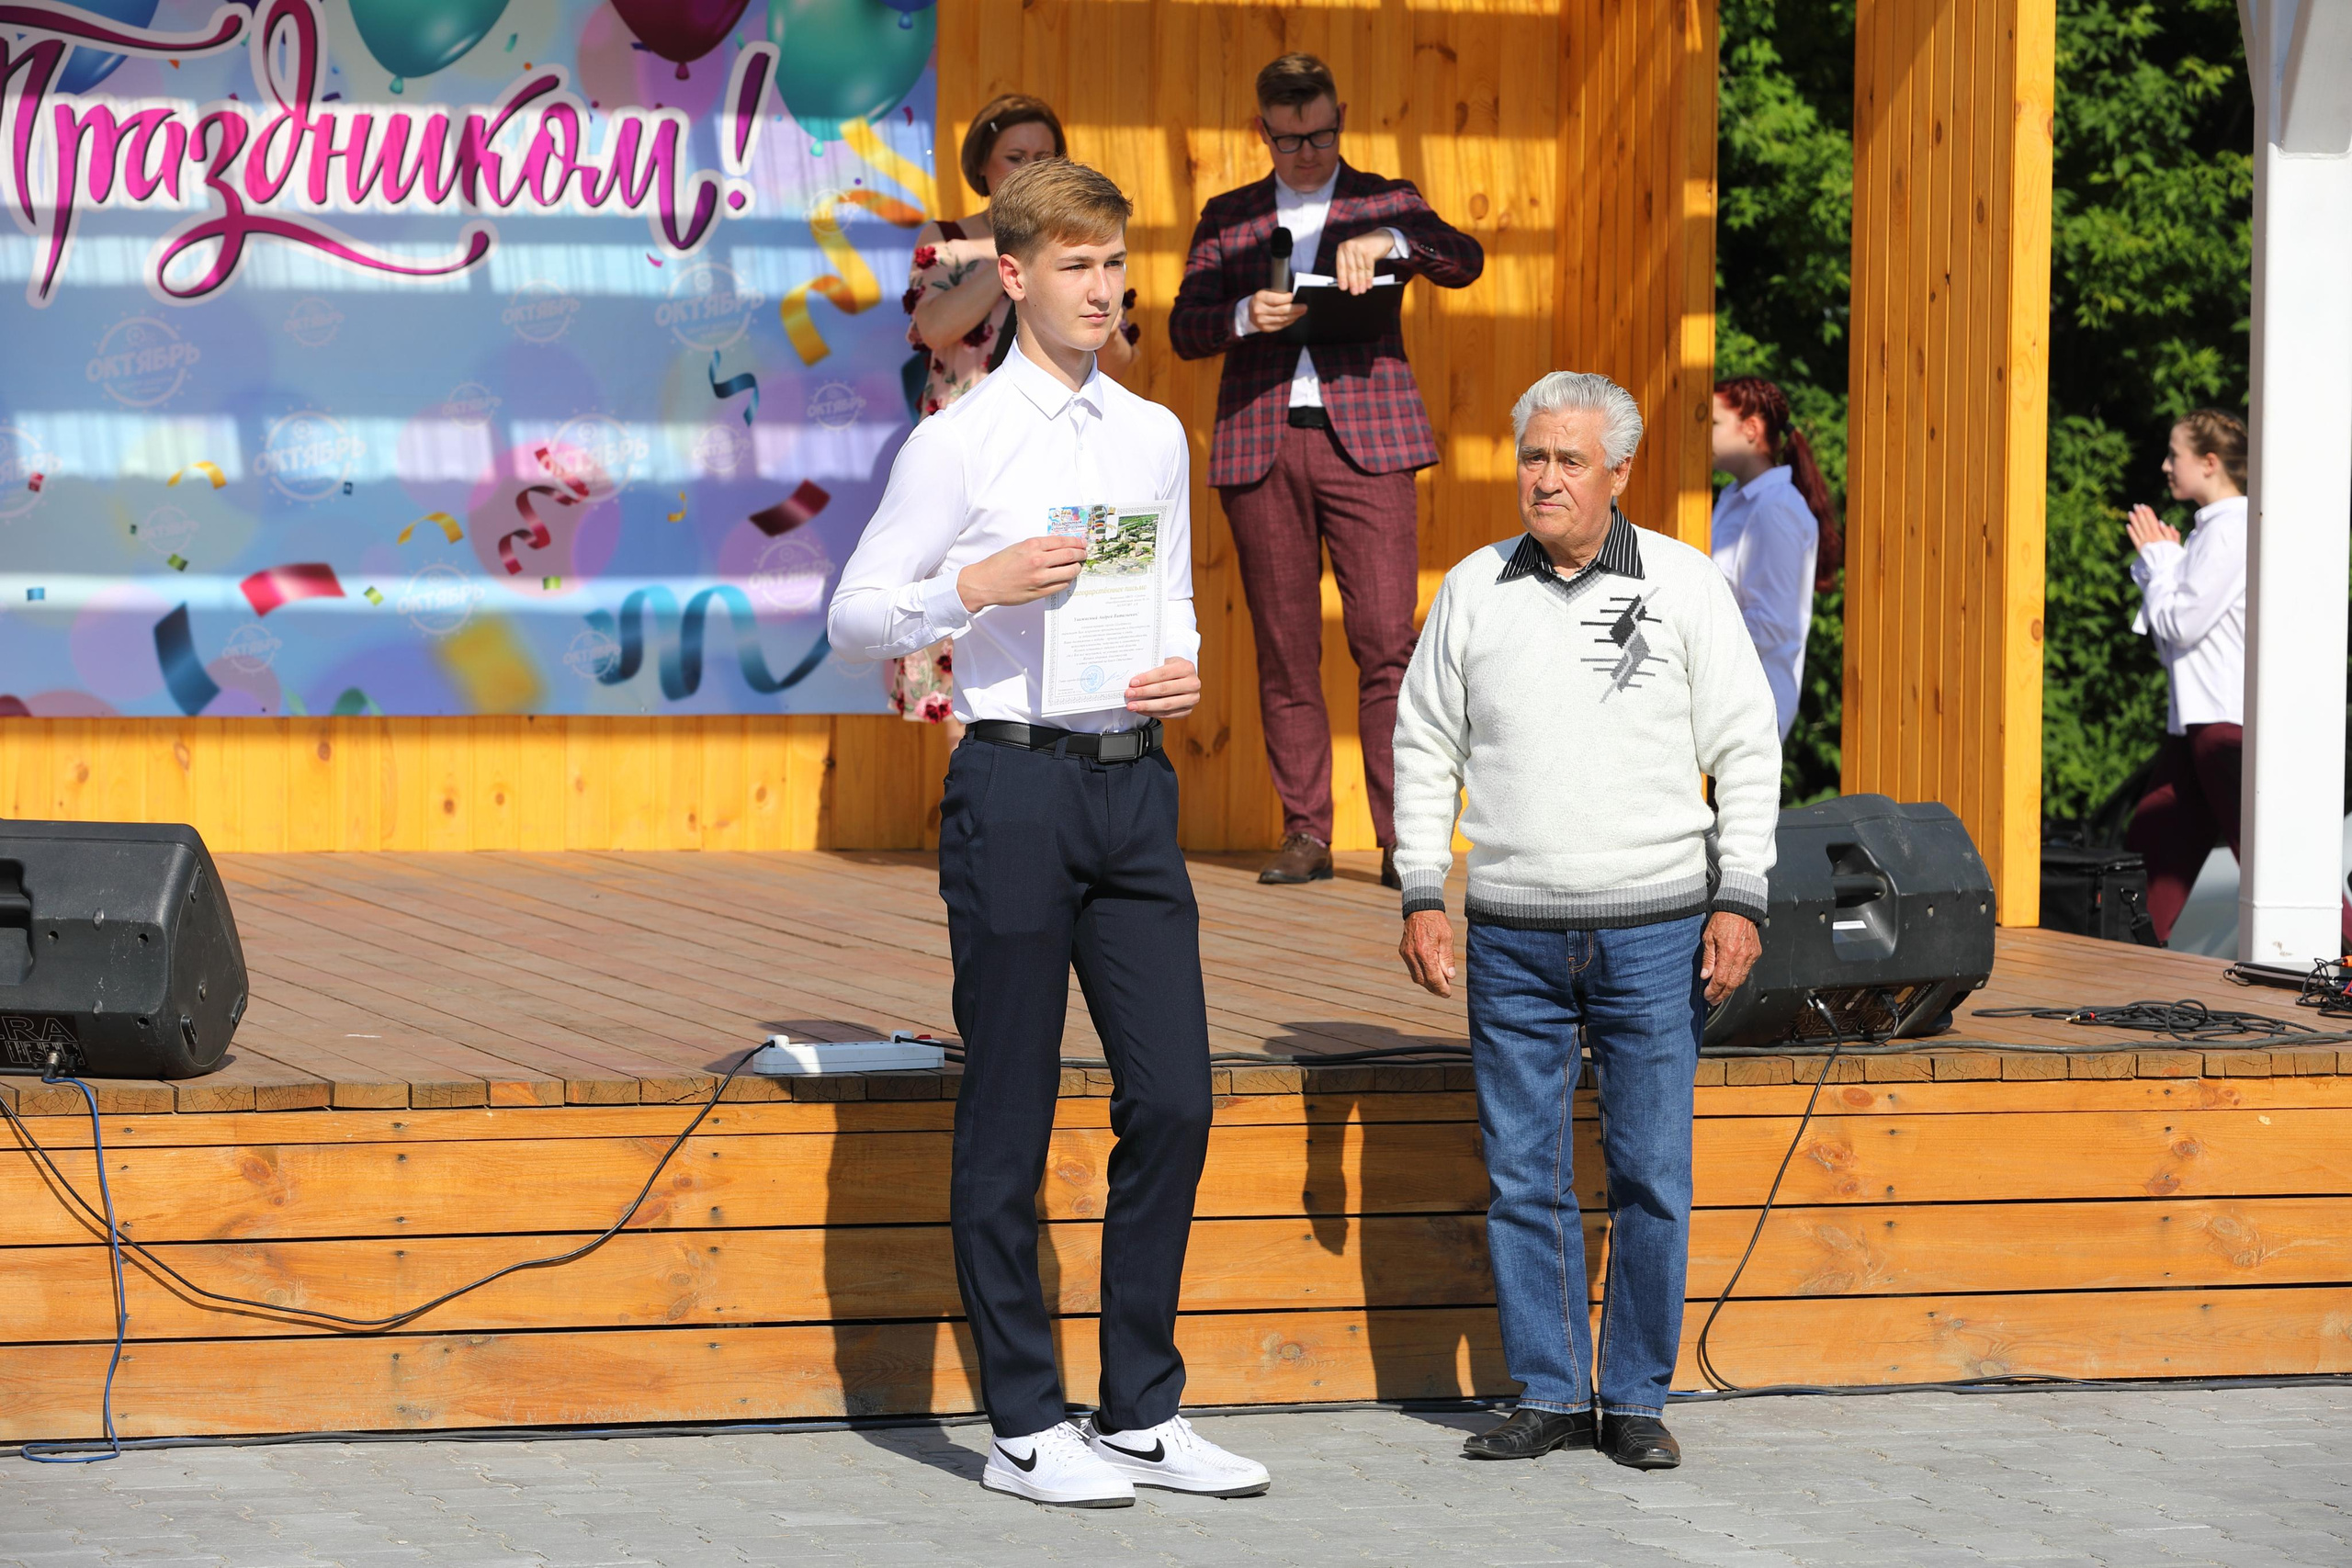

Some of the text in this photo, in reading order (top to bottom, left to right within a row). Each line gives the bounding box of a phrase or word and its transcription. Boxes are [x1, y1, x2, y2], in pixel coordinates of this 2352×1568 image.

[501, 297, 581, 325] ОКТЯБРЬ
[655, 288, 765, 327] ОКТЯБРЬ
[85, 342, 200, 382] ОКТЯБРЬ
[253, 434, 366, 477] ОКТЯБРЬ
[537, 438, 649, 479] ОКТЯБРЬ
[397, 583, 485, 616] ОКТЯБРЬ
